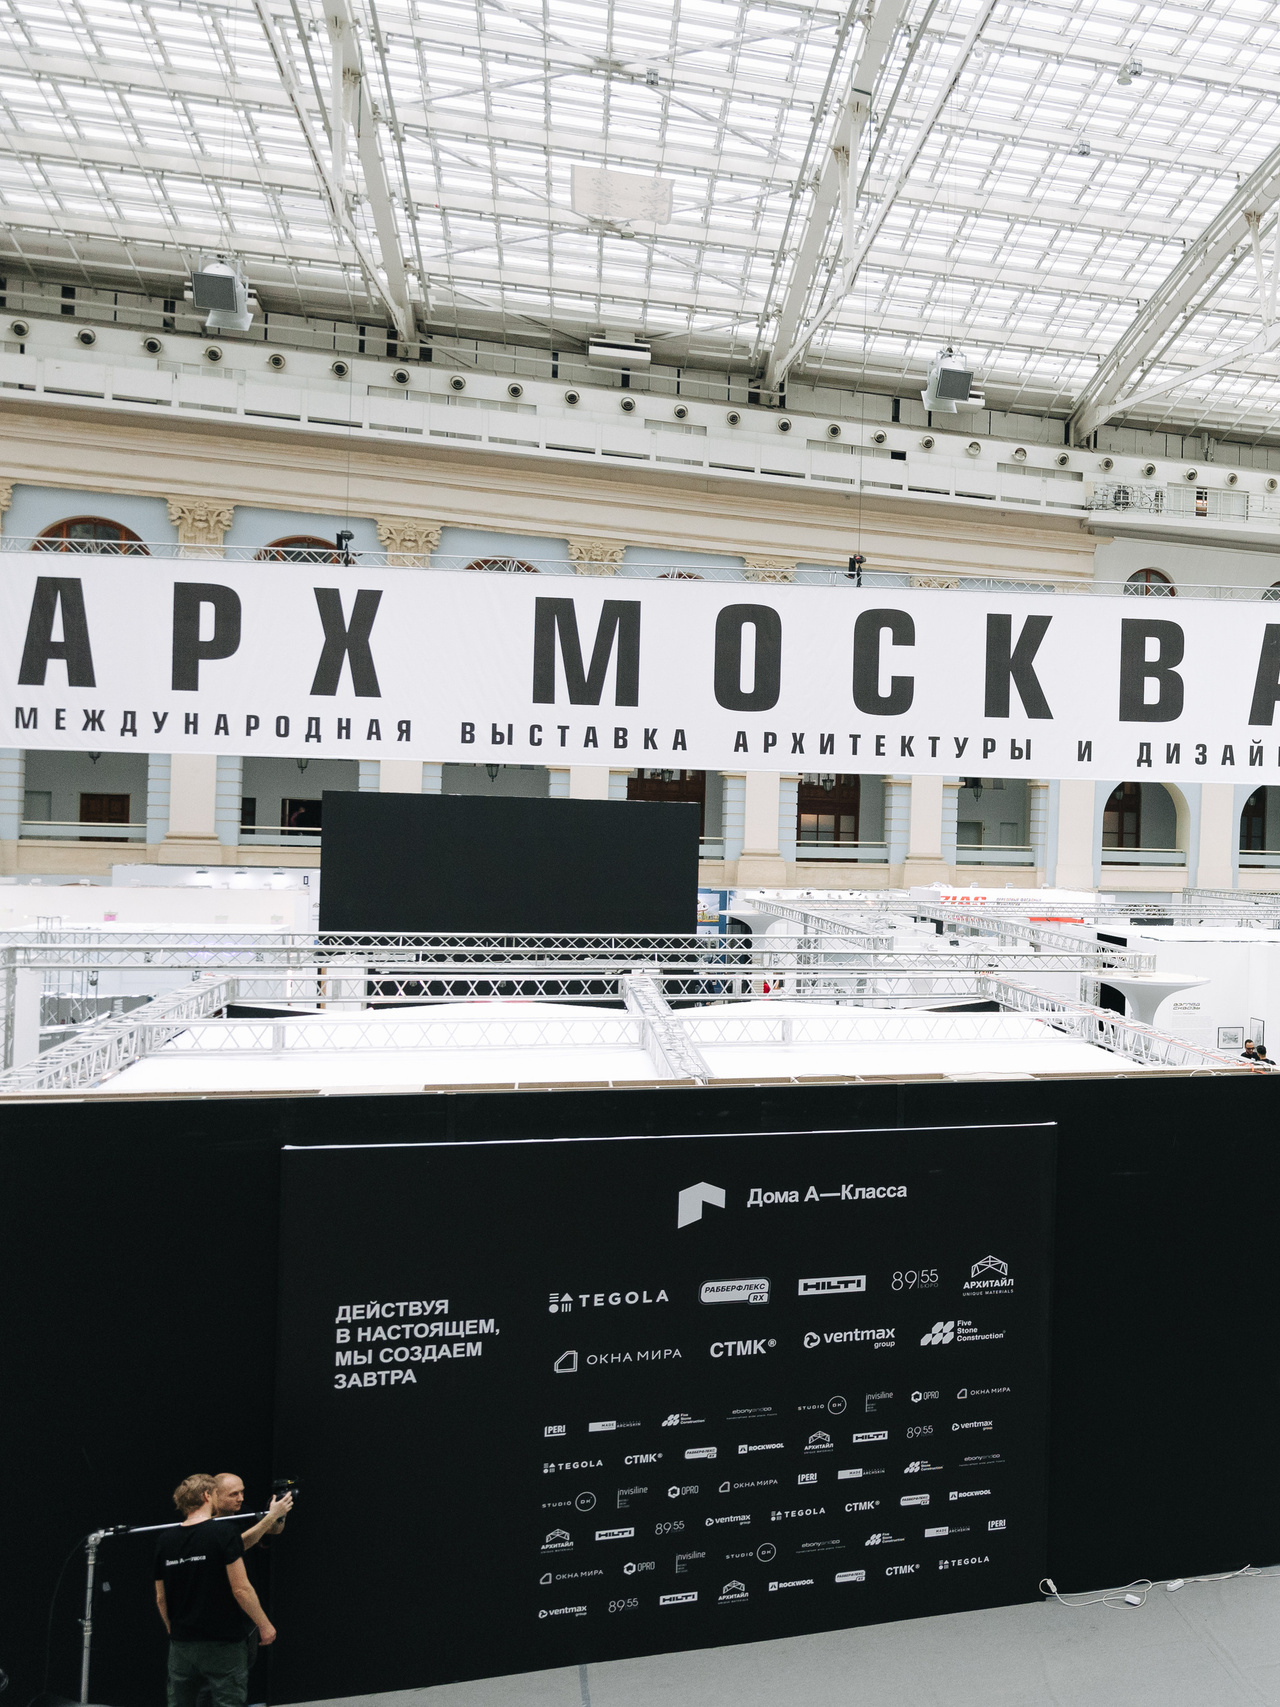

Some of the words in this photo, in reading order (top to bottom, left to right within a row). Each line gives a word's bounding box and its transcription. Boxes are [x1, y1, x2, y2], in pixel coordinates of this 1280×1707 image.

[18, 577, 383, 698] АРХ
[15, 707, 411, 742] МЕЖДУНАРОДНАЯ
[460, 721, 688, 751] ВЫСТАВКА
[734, 731, 1032, 761] АРХИТЕКТУРЫ
[1077, 741, 1092, 762] И
[747, 1187, 799, 1208] Дома
[704, 1282, 766, 1294] РАББЕРФЛЕКС
[802, 1278, 862, 1292] HILTI
[963, 1277, 1014, 1290] АРХИТАЙЛ
[579, 1289, 670, 1308] TEGOLA
[752, 1294, 765, 1302] RX
[335, 1299, 449, 1324] ДЕЙСТВУЯ
[336, 1328, 350, 1344] В
[357, 1318, 500, 1342] НАСТОЯЩЕМ,
[823, 1327, 896, 1344] ventmax
[957, 1326, 978, 1334] Stone
[957, 1332, 1004, 1342] Construction
[874, 1341, 896, 1349] group
[335, 1349, 372, 1367] МЫ
[379, 1341, 483, 1363] СОЗДАЕМ
[587, 1353, 633, 1365] ОКНА
[637, 1348, 682, 1361] МИРА
[334, 1368, 418, 1389] ЗАВТРА
[961, 1420, 993, 1429] ventmax
[748, 1442, 785, 1452] ROCKWOOL
[804, 1443, 834, 1451] АРХИТАЙЛ
[558, 1459, 603, 1470] TEGOLA
[756, 1479, 778, 1487] МИРА
[958, 1489, 991, 1498] ROCKWOOL
[784, 1507, 826, 1519] TEGOLA
[715, 1514, 751, 1525] ventmax
[541, 1541, 574, 1550] АРХИТАЙЛ
[951, 1555, 990, 1567] TEGOLA
[580, 1569, 603, 1577] МИРА
[779, 1579, 814, 1588] ROCKWOOL
[718, 1592, 749, 1601] АРХИТАЙЛ
[549, 1605, 587, 1616] ventmax
